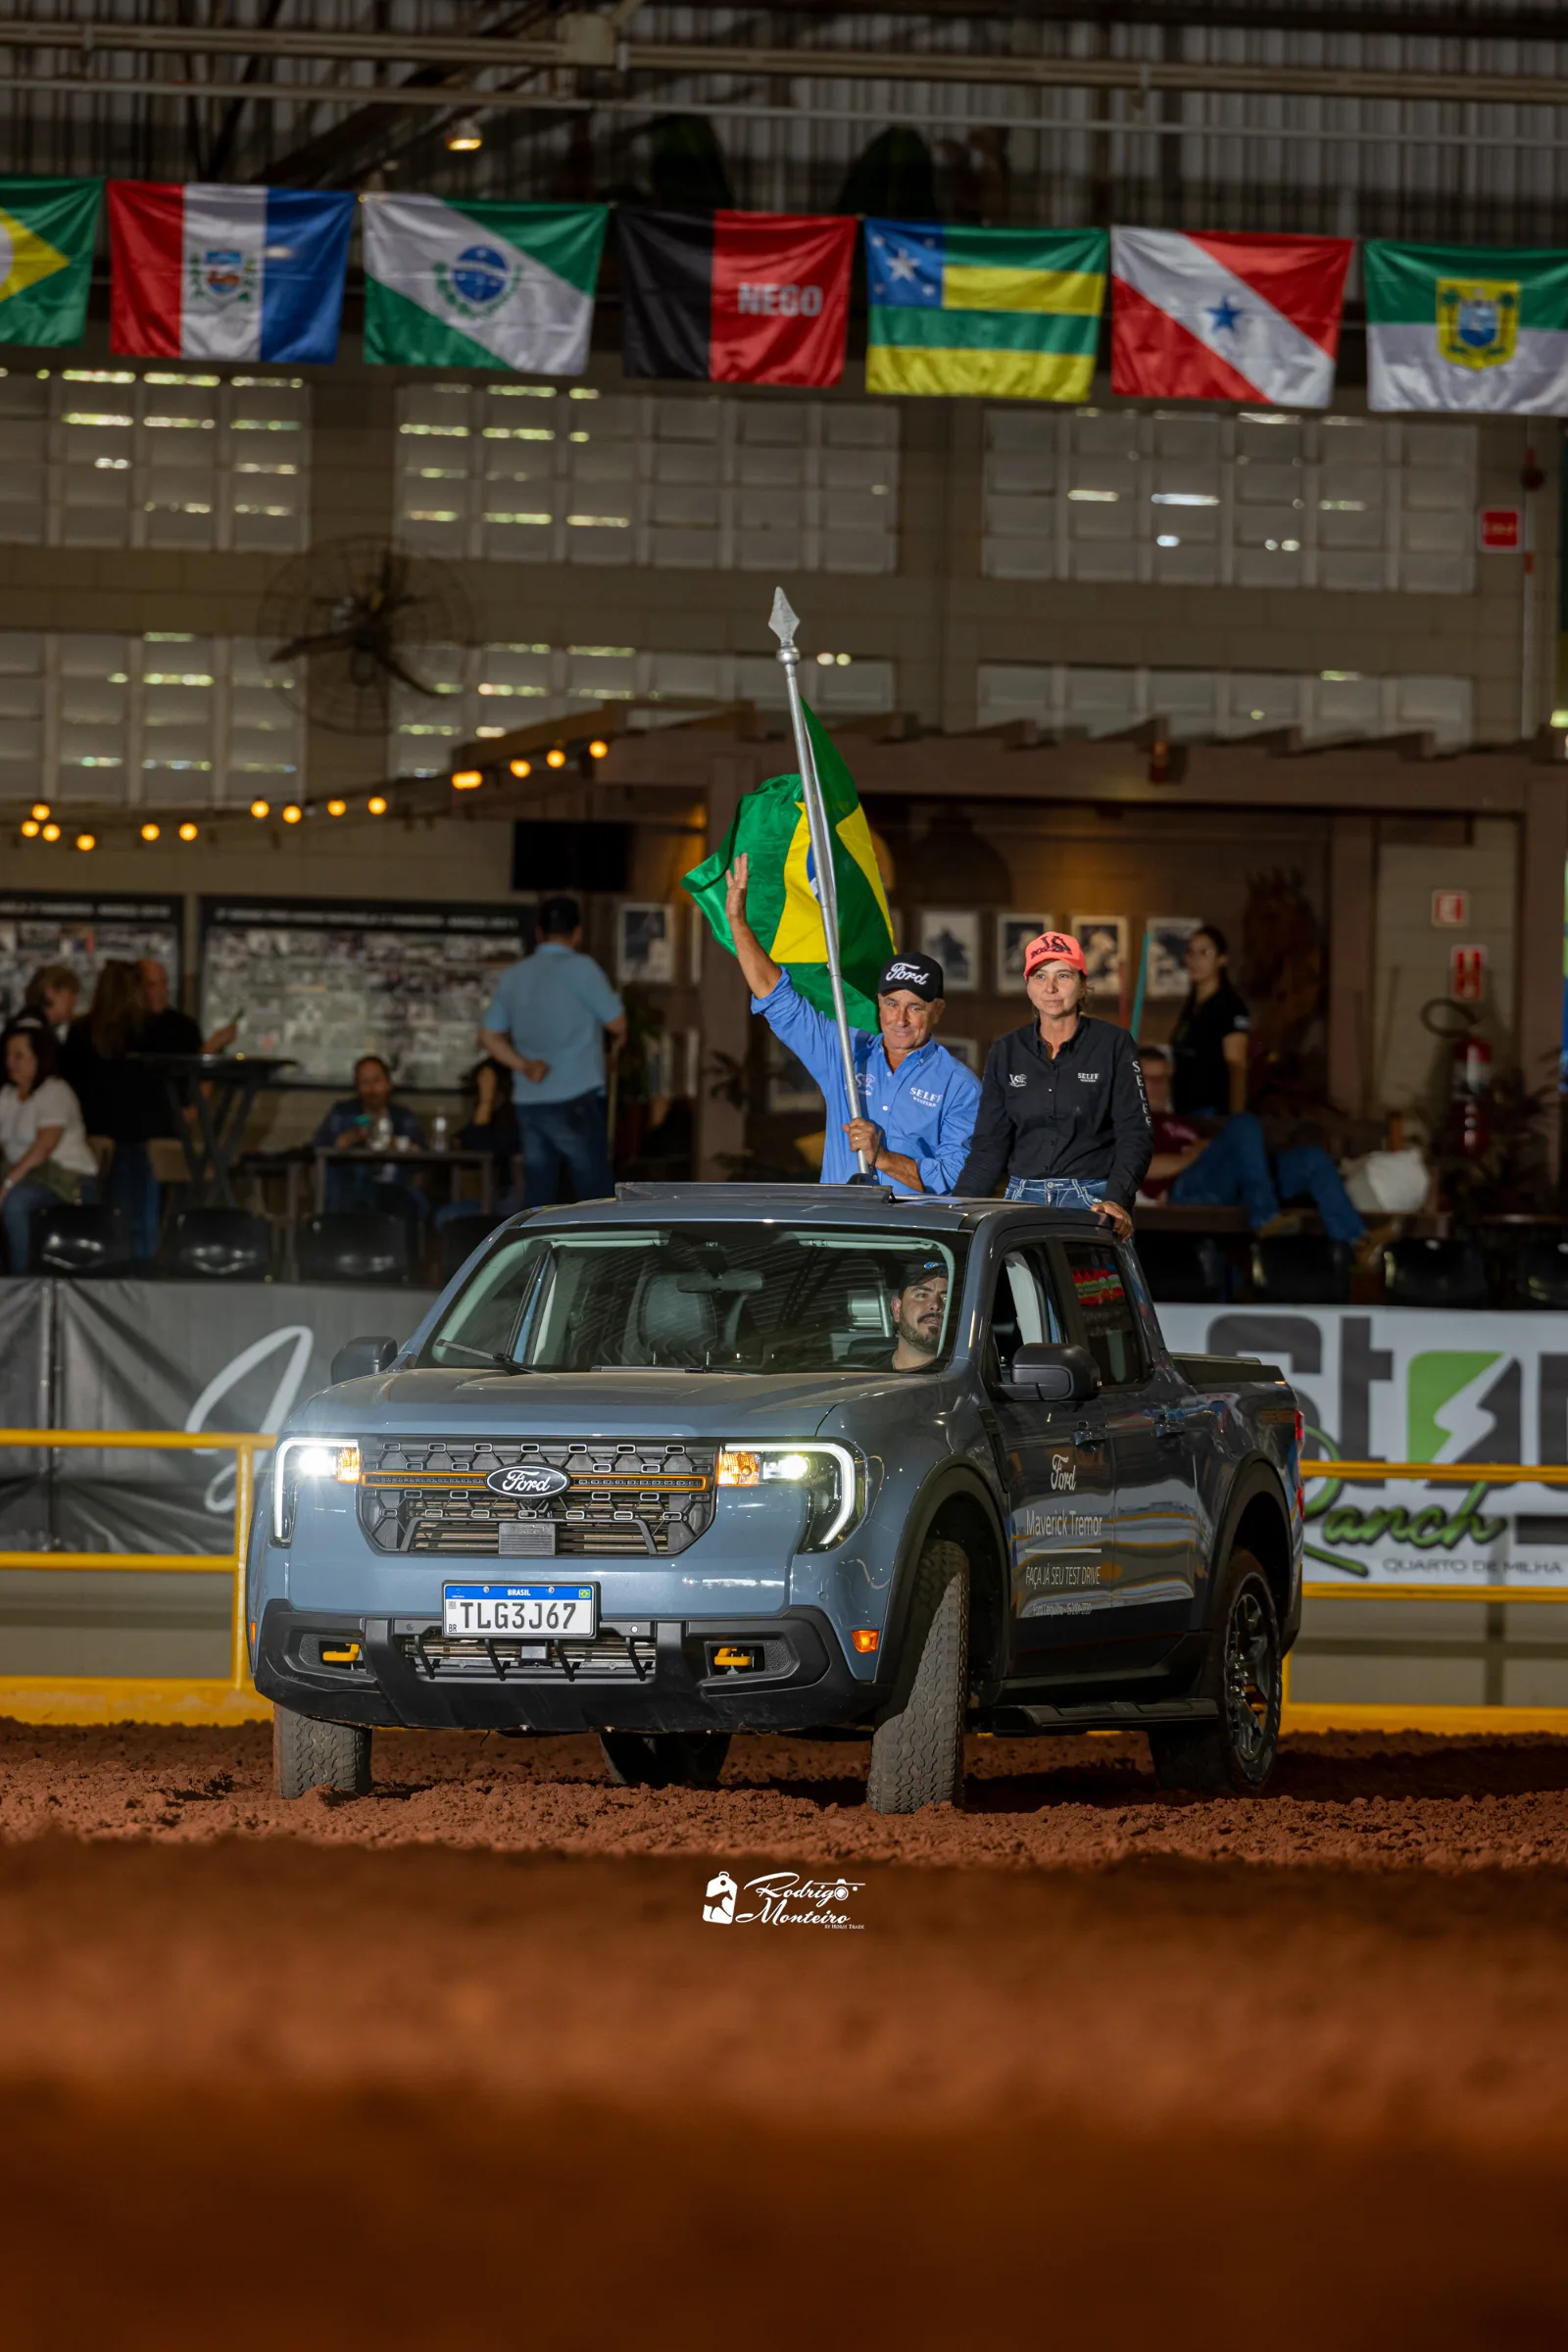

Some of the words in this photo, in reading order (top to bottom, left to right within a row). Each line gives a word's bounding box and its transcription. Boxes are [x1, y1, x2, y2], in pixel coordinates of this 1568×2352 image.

[737, 282, 823, 318] NEGO
[886, 961, 929, 985] Ford
[909, 1087, 943, 1102] SELFF
[502, 1470, 551, 1492] Ford
[1051, 1453, 1076, 1491] Ford
[1026, 1508, 1067, 1536] Maverick
[1069, 1510, 1102, 1536] Tremor
[1025, 1566, 1042, 1590] FAÇA
[1042, 1562, 1051, 1585] JÁ
[1051, 1566, 1064, 1585] SEU
[1065, 1566, 1081, 1585] TEST
[1081, 1566, 1102, 1585] DRIVE
[1382, 1557, 1466, 1573] QUARTO
[1472, 1558, 1499, 1573] DE
[1502, 1559, 1562, 1575] MILHA
[448, 1623, 458, 1633] BR
[460, 1601, 576, 1630] TLG3J67
